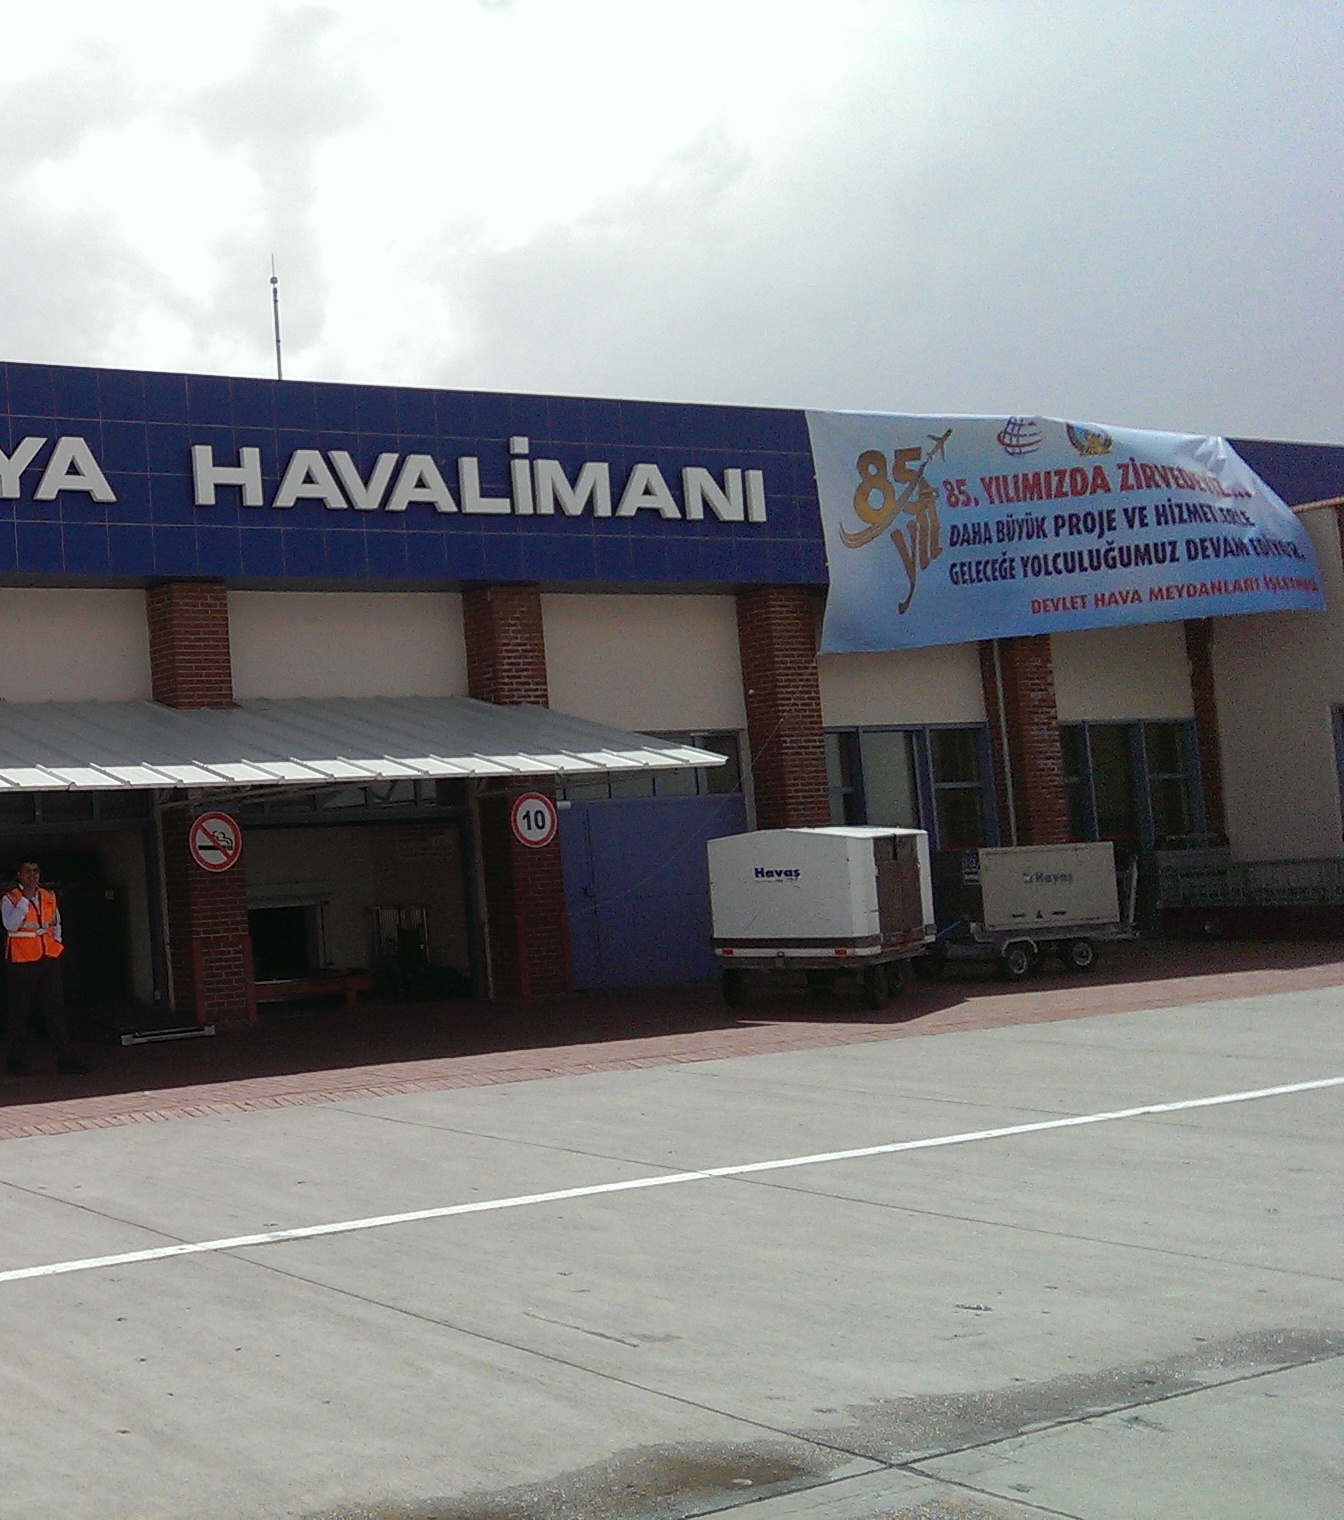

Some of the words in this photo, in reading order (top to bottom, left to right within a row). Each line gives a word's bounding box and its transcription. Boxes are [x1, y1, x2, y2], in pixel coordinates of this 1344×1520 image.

[191, 435, 766, 523] HAVALİMANI
[942, 478, 980, 508] 85.
[980, 465, 1112, 506] YILIMIZDA
[948, 520, 994, 548] DAHA
[995, 512, 1048, 543] BÜYÜK
[1053, 508, 1118, 539] PROJE
[1122, 502, 1150, 530] VE
[948, 551, 1017, 586] GELECEĞE
[1020, 540, 1181, 580] YOLCULUĞUMUZ
[1185, 535, 1250, 560] DEVAM
[1030, 593, 1088, 615] DEVLET
[1093, 588, 1144, 607] HAVA
[1148, 577, 1261, 602] MEYDANLARI
[522, 809, 546, 831] 10
